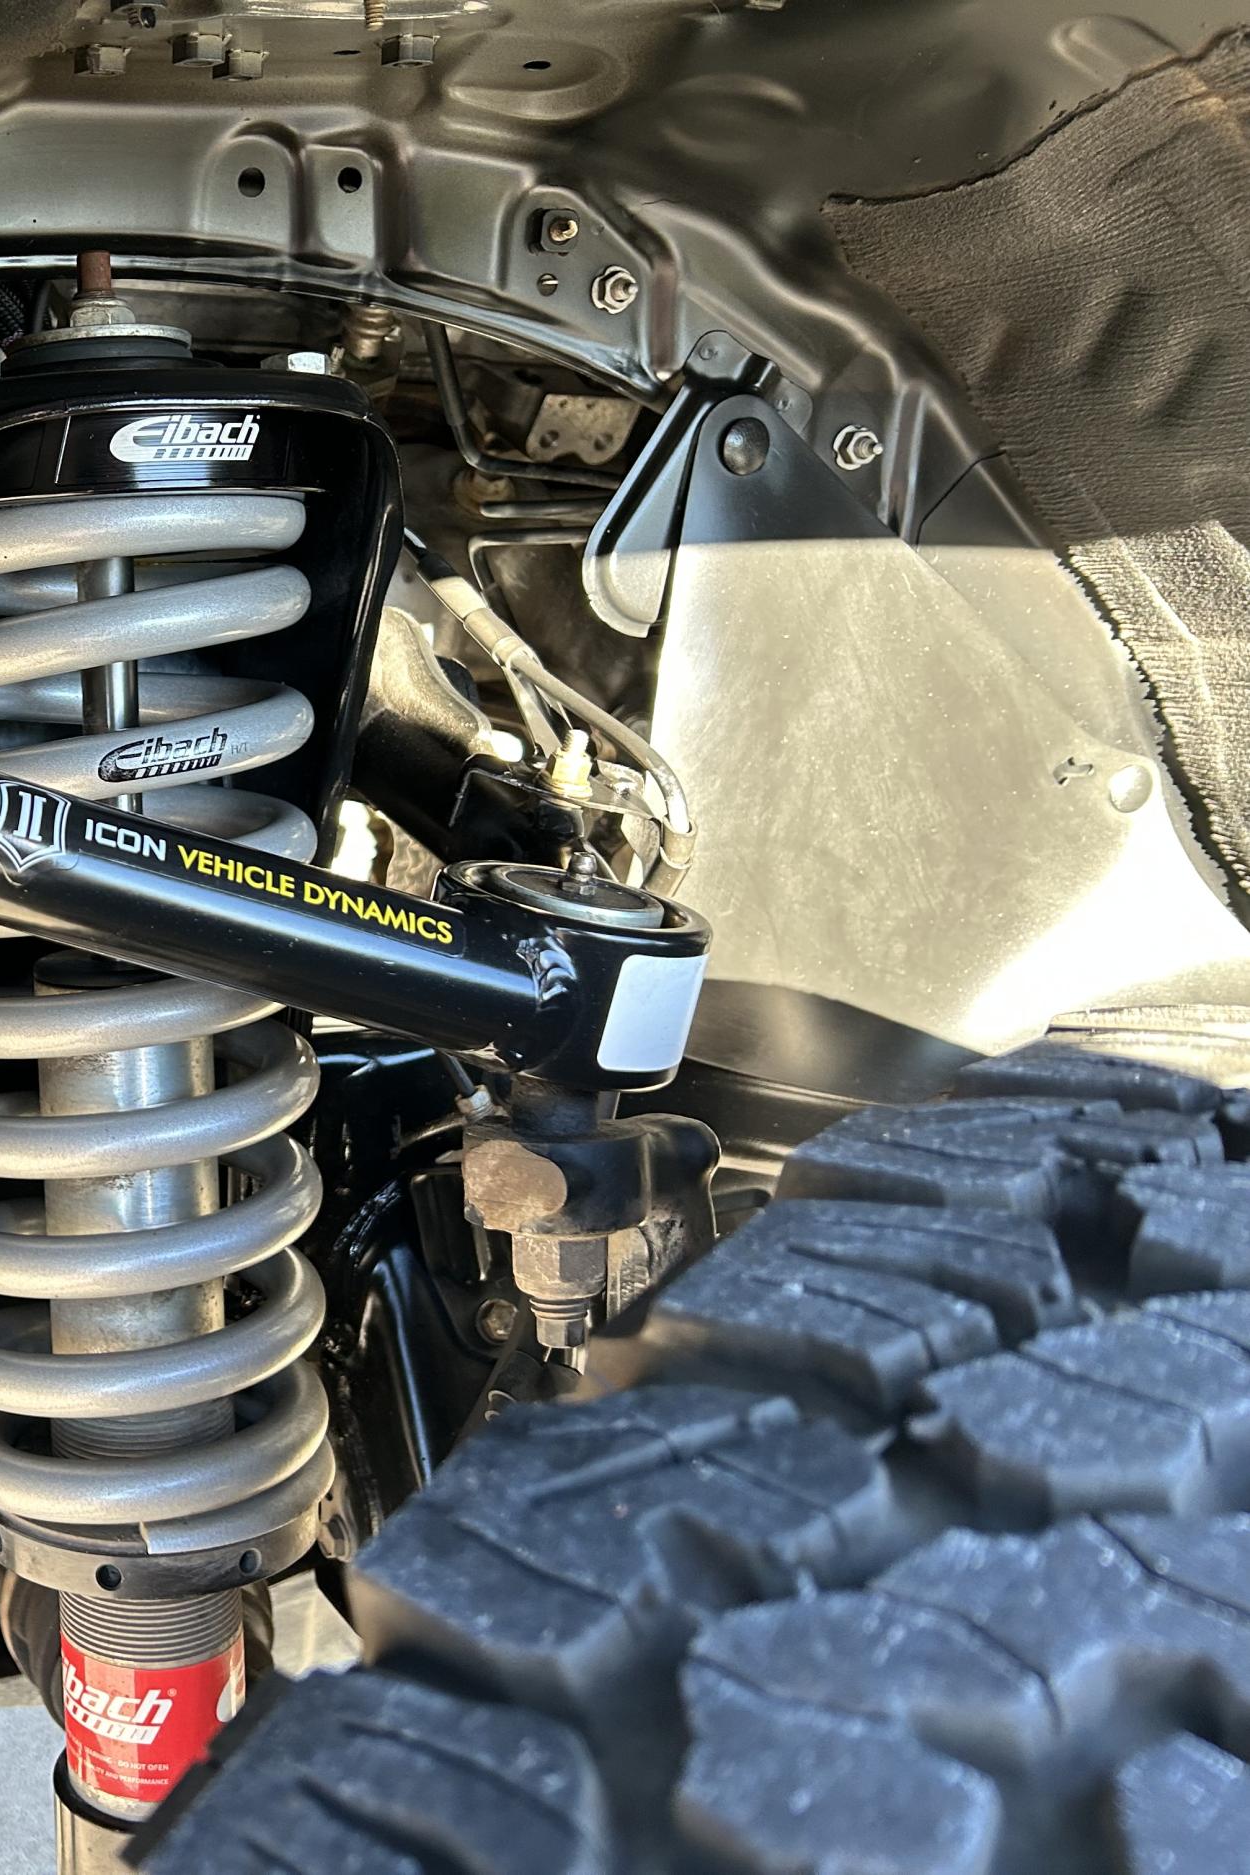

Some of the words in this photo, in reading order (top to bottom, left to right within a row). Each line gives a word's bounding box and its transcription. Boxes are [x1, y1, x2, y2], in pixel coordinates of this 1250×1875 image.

[109, 414, 261, 463] Eibach
[98, 726, 228, 783] Eibach
[84, 818, 167, 862] ICON
[178, 845, 296, 899] VEHICLE
[303, 879, 454, 944] DYNAMICS
[62, 1658, 173, 1727] ibach
